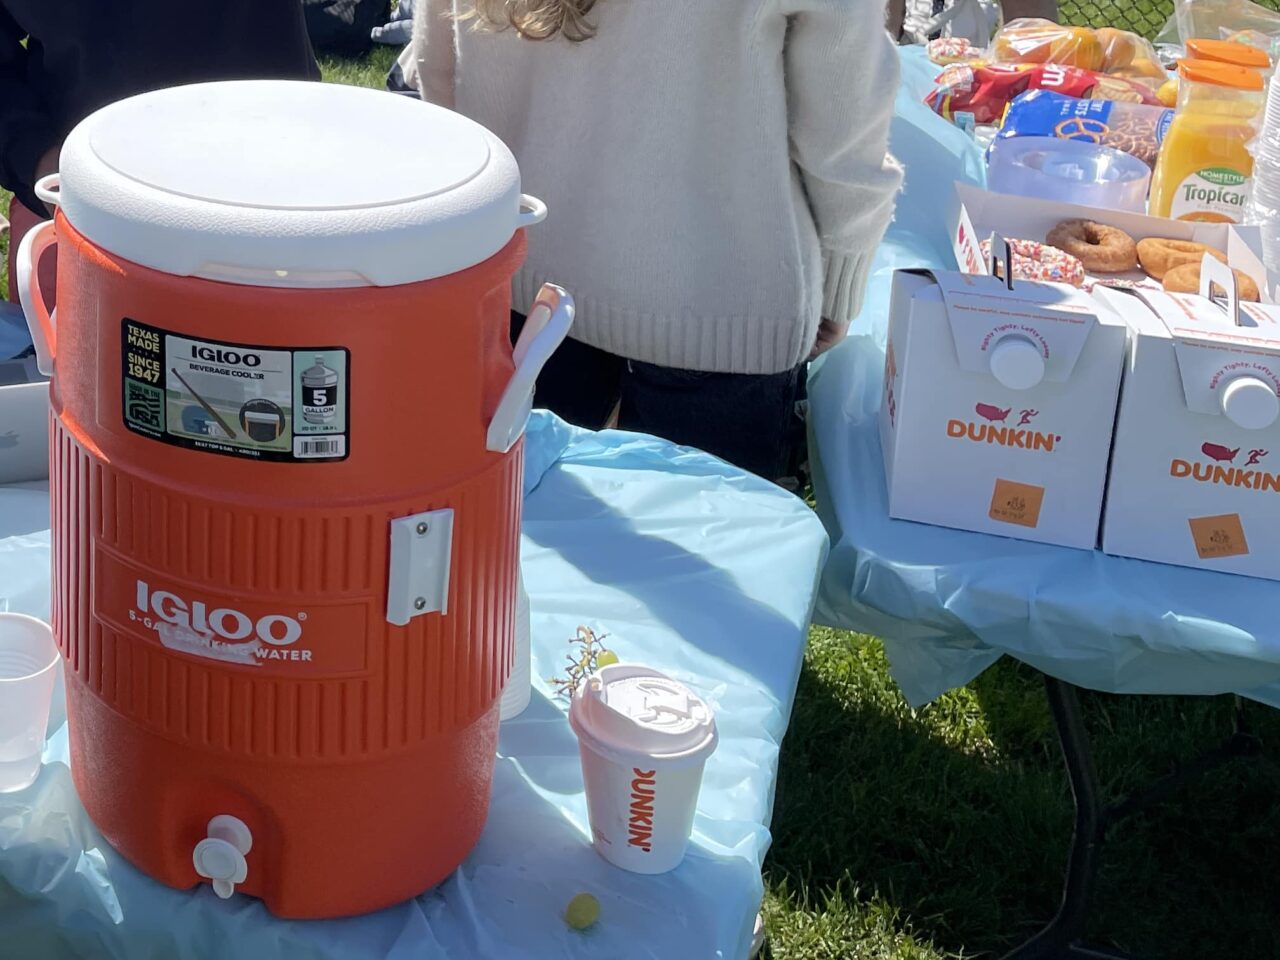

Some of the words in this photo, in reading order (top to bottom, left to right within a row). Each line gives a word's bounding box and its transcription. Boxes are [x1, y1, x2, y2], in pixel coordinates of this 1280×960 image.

[1200, 170, 1245, 182] HOMESTYLE
[127, 324, 160, 342] TEXAS
[128, 334, 160, 353] MADE
[128, 352, 160, 371] SINCE
[192, 345, 262, 367] IGLOO
[128, 363, 160, 383] 1947
[189, 363, 231, 376] BEVERAGE
[231, 370, 265, 380] COOLER
[313, 389, 327, 406] 5
[947, 419, 1062, 452] DUNKIN'
[137, 580, 302, 646] IGLOO
[255, 647, 312, 661] WATER
[628, 767, 657, 853] DUNKIN'
